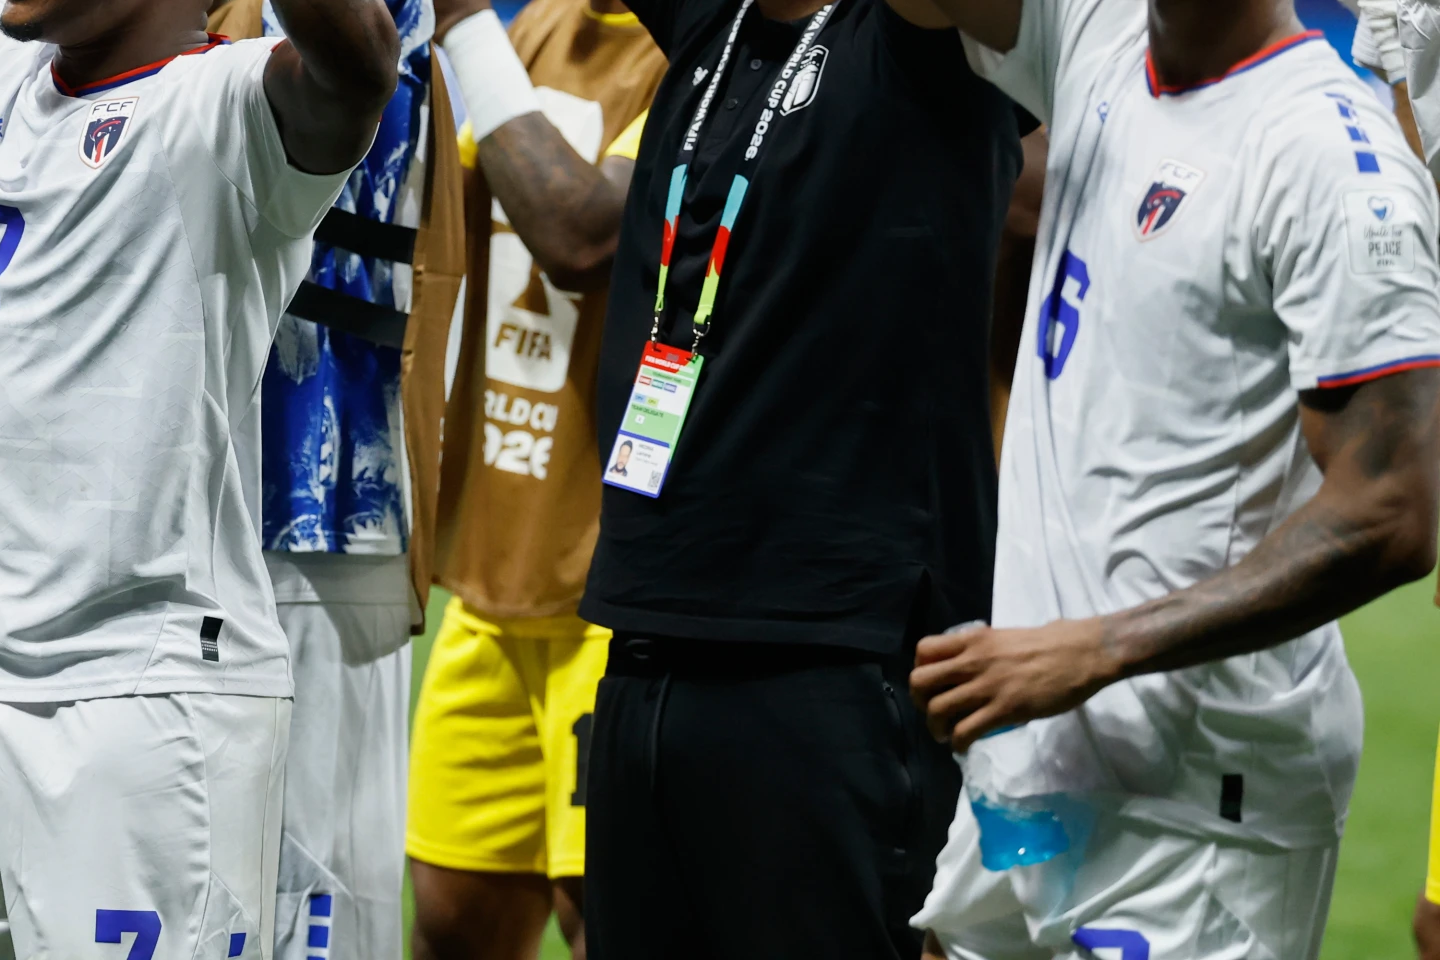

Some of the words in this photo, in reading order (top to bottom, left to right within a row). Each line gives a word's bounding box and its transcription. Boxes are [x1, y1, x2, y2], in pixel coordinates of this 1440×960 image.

[807, 4, 833, 31] FIFA
[781, 31, 815, 79] WORLD
[91, 101, 134, 115] FCF
[767, 79, 788, 109] CUP
[683, 121, 703, 151] FIFA
[695, 72, 721, 122] WORLD
[1368, 240, 1402, 257] PEACE
[1037, 248, 1091, 381] 6
[494, 322, 552, 361] FIFA
